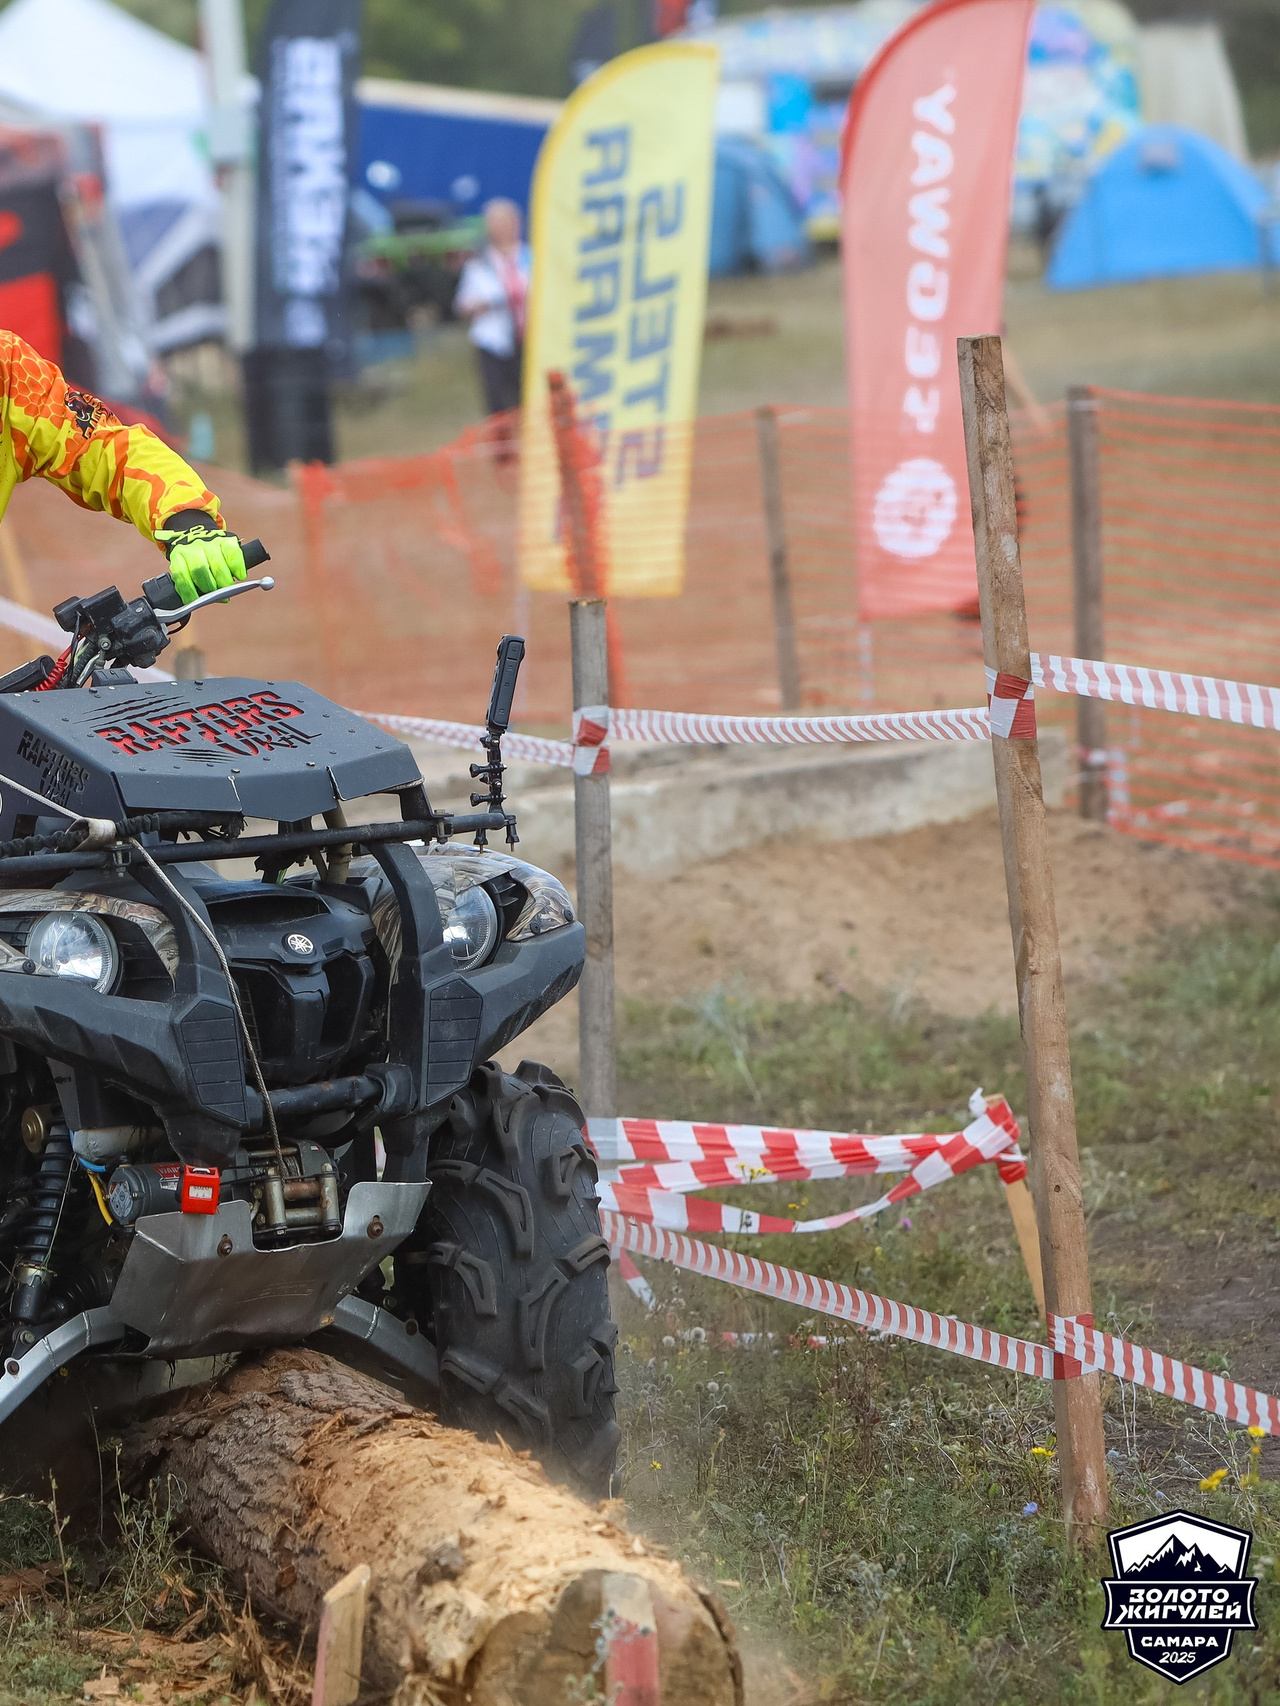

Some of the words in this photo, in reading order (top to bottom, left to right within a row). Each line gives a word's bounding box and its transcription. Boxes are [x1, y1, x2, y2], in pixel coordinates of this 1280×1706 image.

[93, 690, 305, 756] RAPTORS
[218, 721, 323, 756] URAL
[16, 729, 91, 795] RAPTORS
